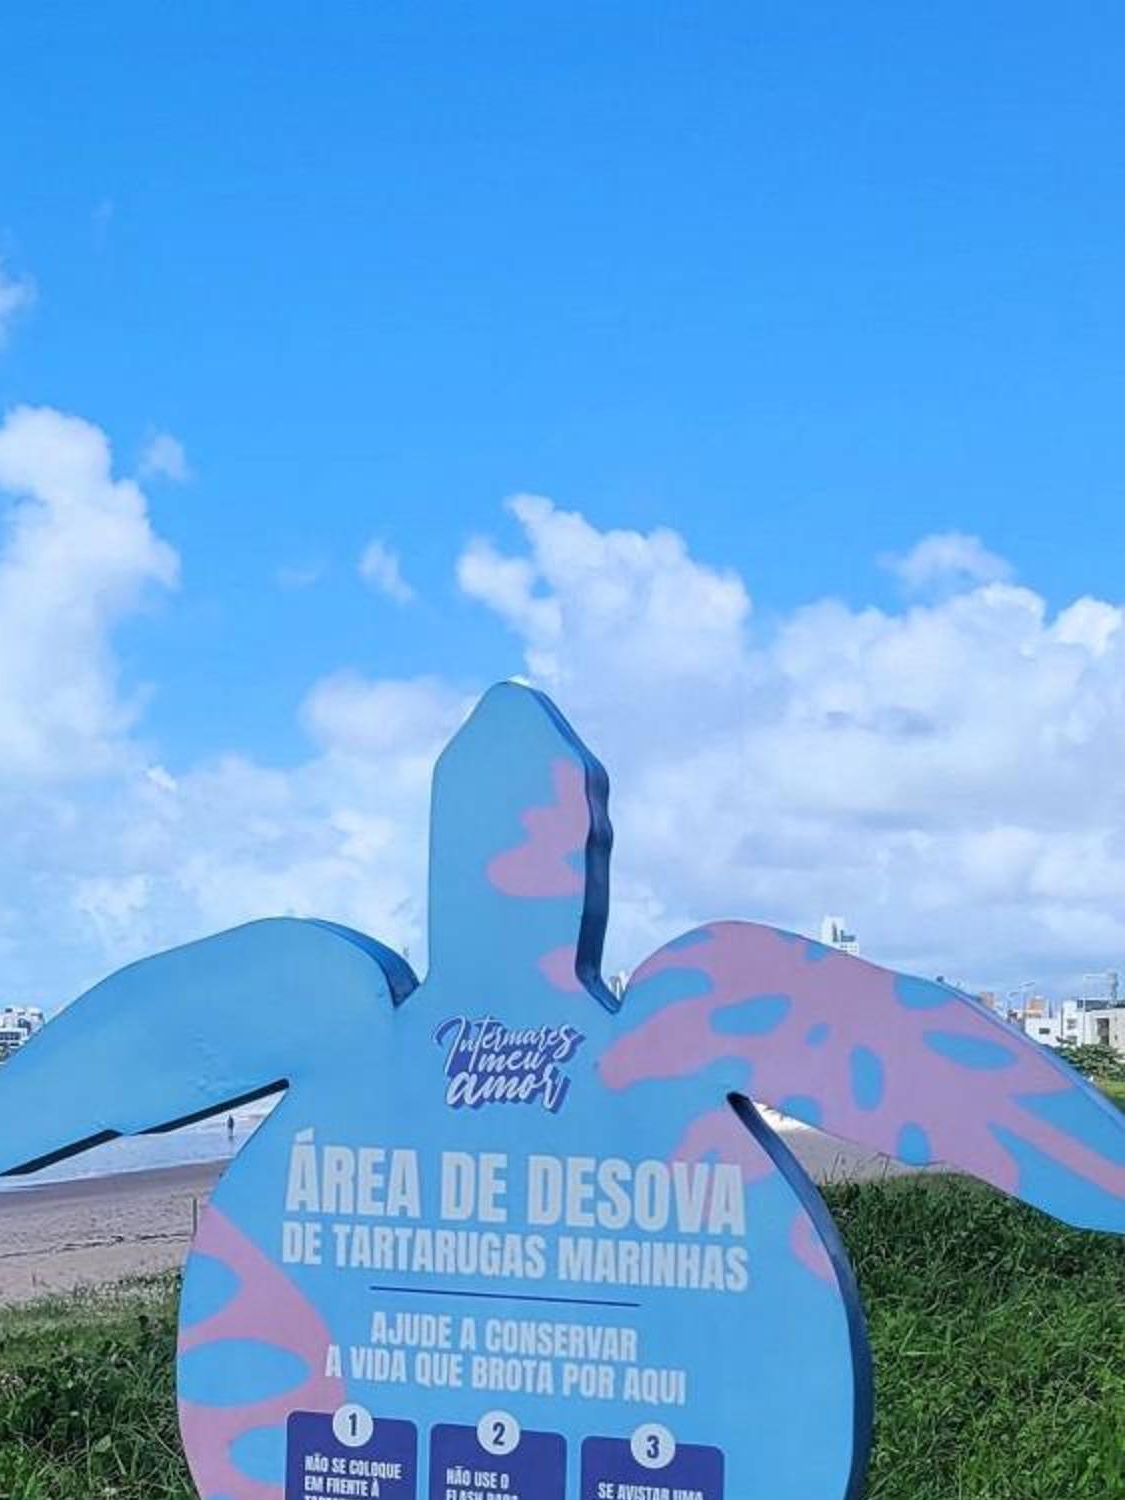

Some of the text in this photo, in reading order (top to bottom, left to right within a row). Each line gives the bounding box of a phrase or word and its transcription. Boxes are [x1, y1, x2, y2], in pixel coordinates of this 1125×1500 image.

[478, 1050, 548, 1072] meu
[446, 1063, 565, 1109] amor
[285, 1126, 747, 1236] ÁREA DE DESOVA
[282, 1221, 749, 1291] DE TARTARUGAS MARINHAS
[371, 1311, 637, 1361] AJUDE A CONSERVAR
[325, 1345, 686, 1404] A VIDA QUE BROTA POR AQUI
[348, 1413, 357, 1436] 1
[492, 1421, 506, 1446] 2
[646, 1435, 660, 1459] 3
[305, 1453, 402, 1479] NÃO SE COLOQUE
[446, 1465, 509, 1489] NÃO USE O
[304, 1475, 323, 1492] EM
[326, 1477, 368, 1496] FRENTE
[597, 1482, 614, 1500] SE
